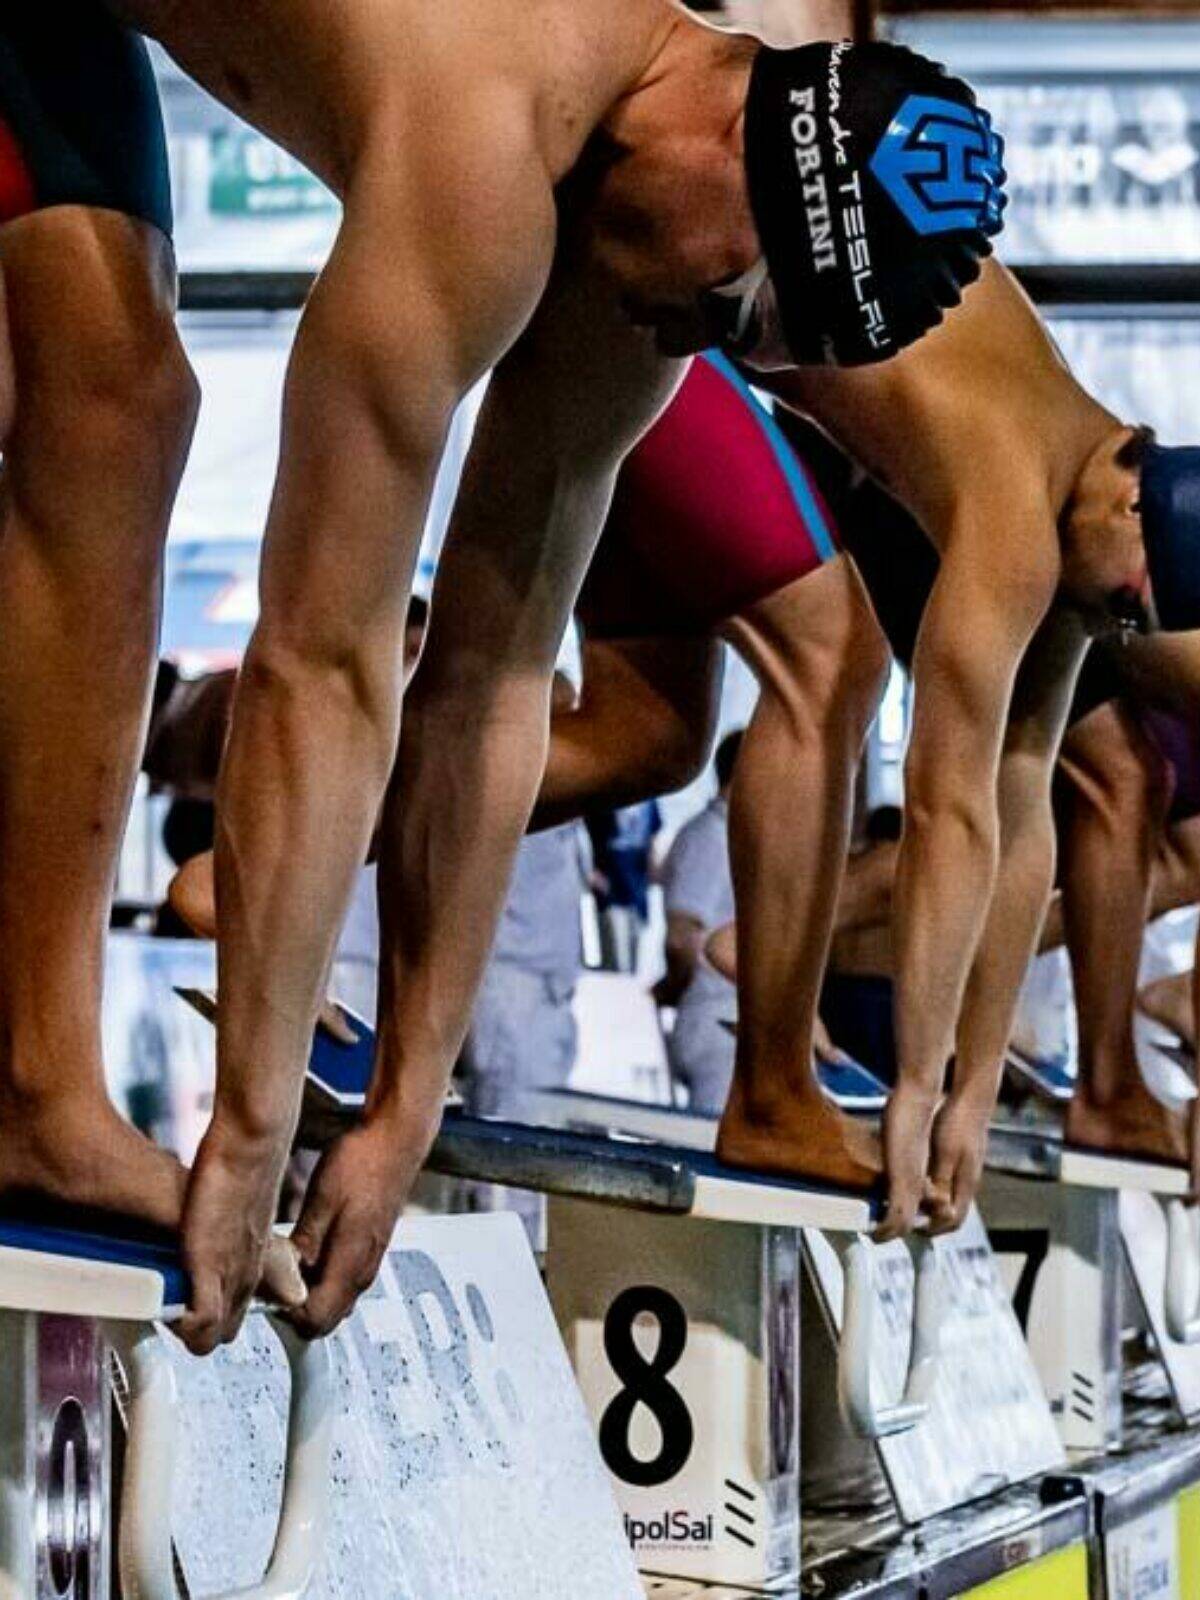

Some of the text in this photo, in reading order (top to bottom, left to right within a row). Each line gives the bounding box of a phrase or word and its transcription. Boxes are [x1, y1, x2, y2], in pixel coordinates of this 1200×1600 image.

[789, 86, 838, 273] FORTINI
[598, 1284, 694, 1488] 8
[623, 1510, 714, 1549] ipolSai
